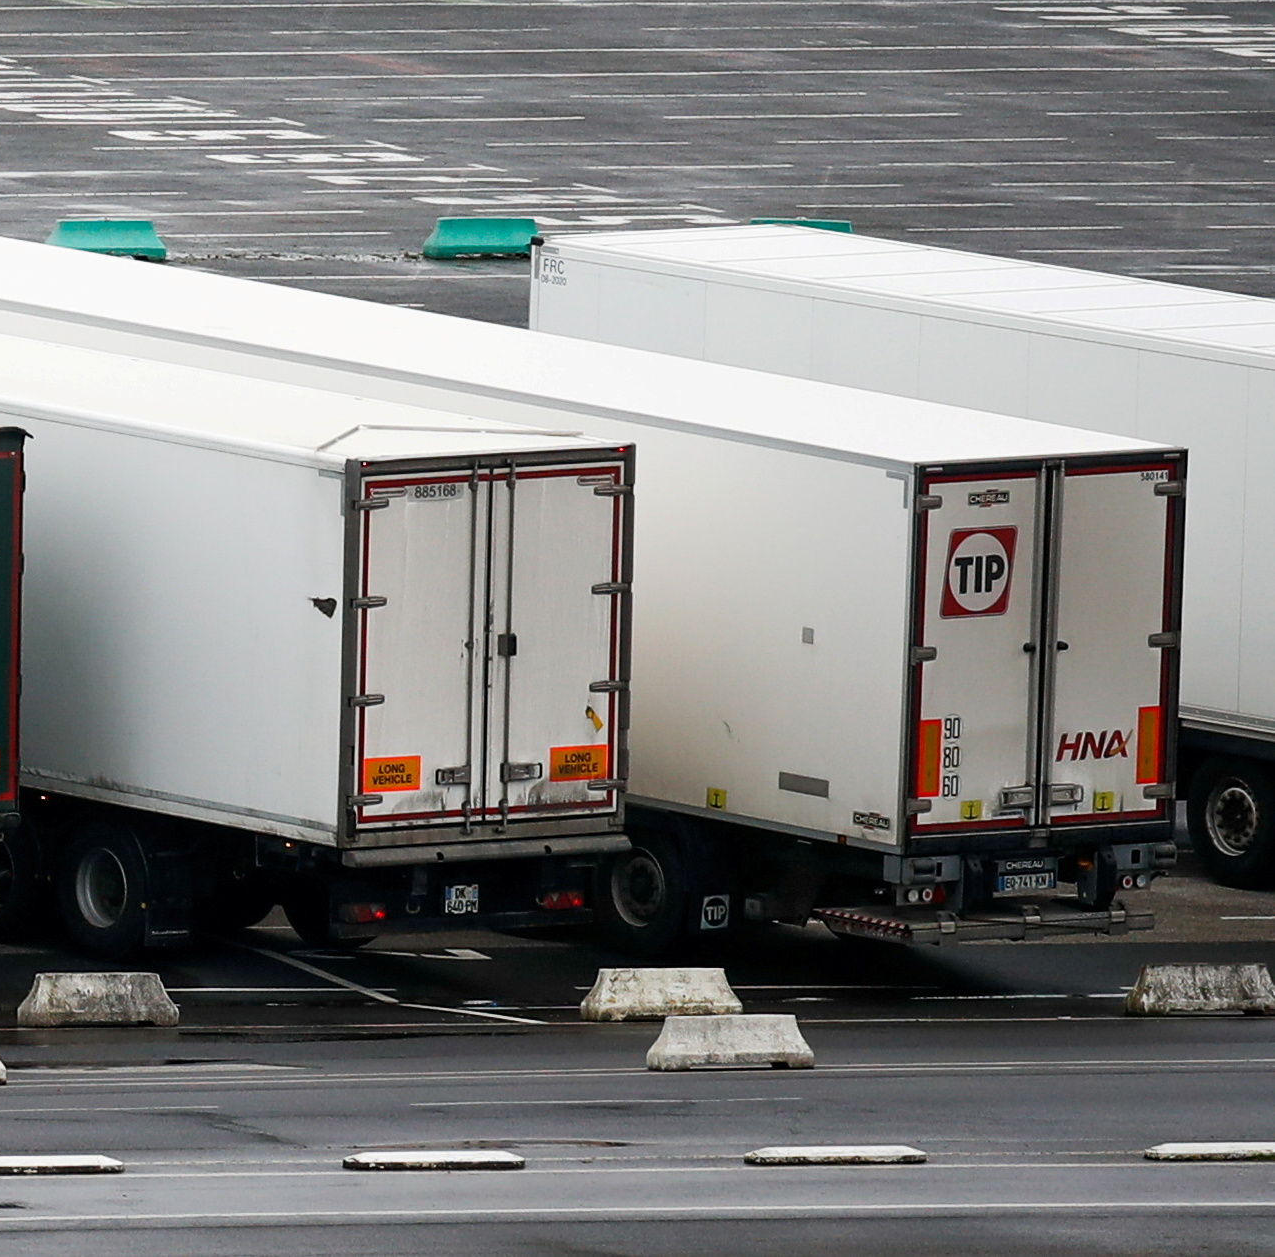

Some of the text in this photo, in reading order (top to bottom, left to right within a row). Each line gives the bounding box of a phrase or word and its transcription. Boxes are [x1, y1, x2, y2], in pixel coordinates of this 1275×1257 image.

[544, 258, 565, 275] FRC
[414, 483, 457, 499] 885168
[969, 493, 1009, 504] CHEREAU
[954, 554, 1005, 594] TIP
[943, 717, 961, 739] 90
[1055, 729, 1134, 762] HNA
[564, 752, 591, 763] LONG
[943, 746, 960, 768] 80
[378, 763, 405, 774] LONG
[558, 762, 599, 774] VEHICLE
[372, 773, 412, 785] VEHICLE
[942, 775, 959, 797] 60
[1005, 860, 1044, 870] CHEREAU
[705, 905, 726, 921] TIP
